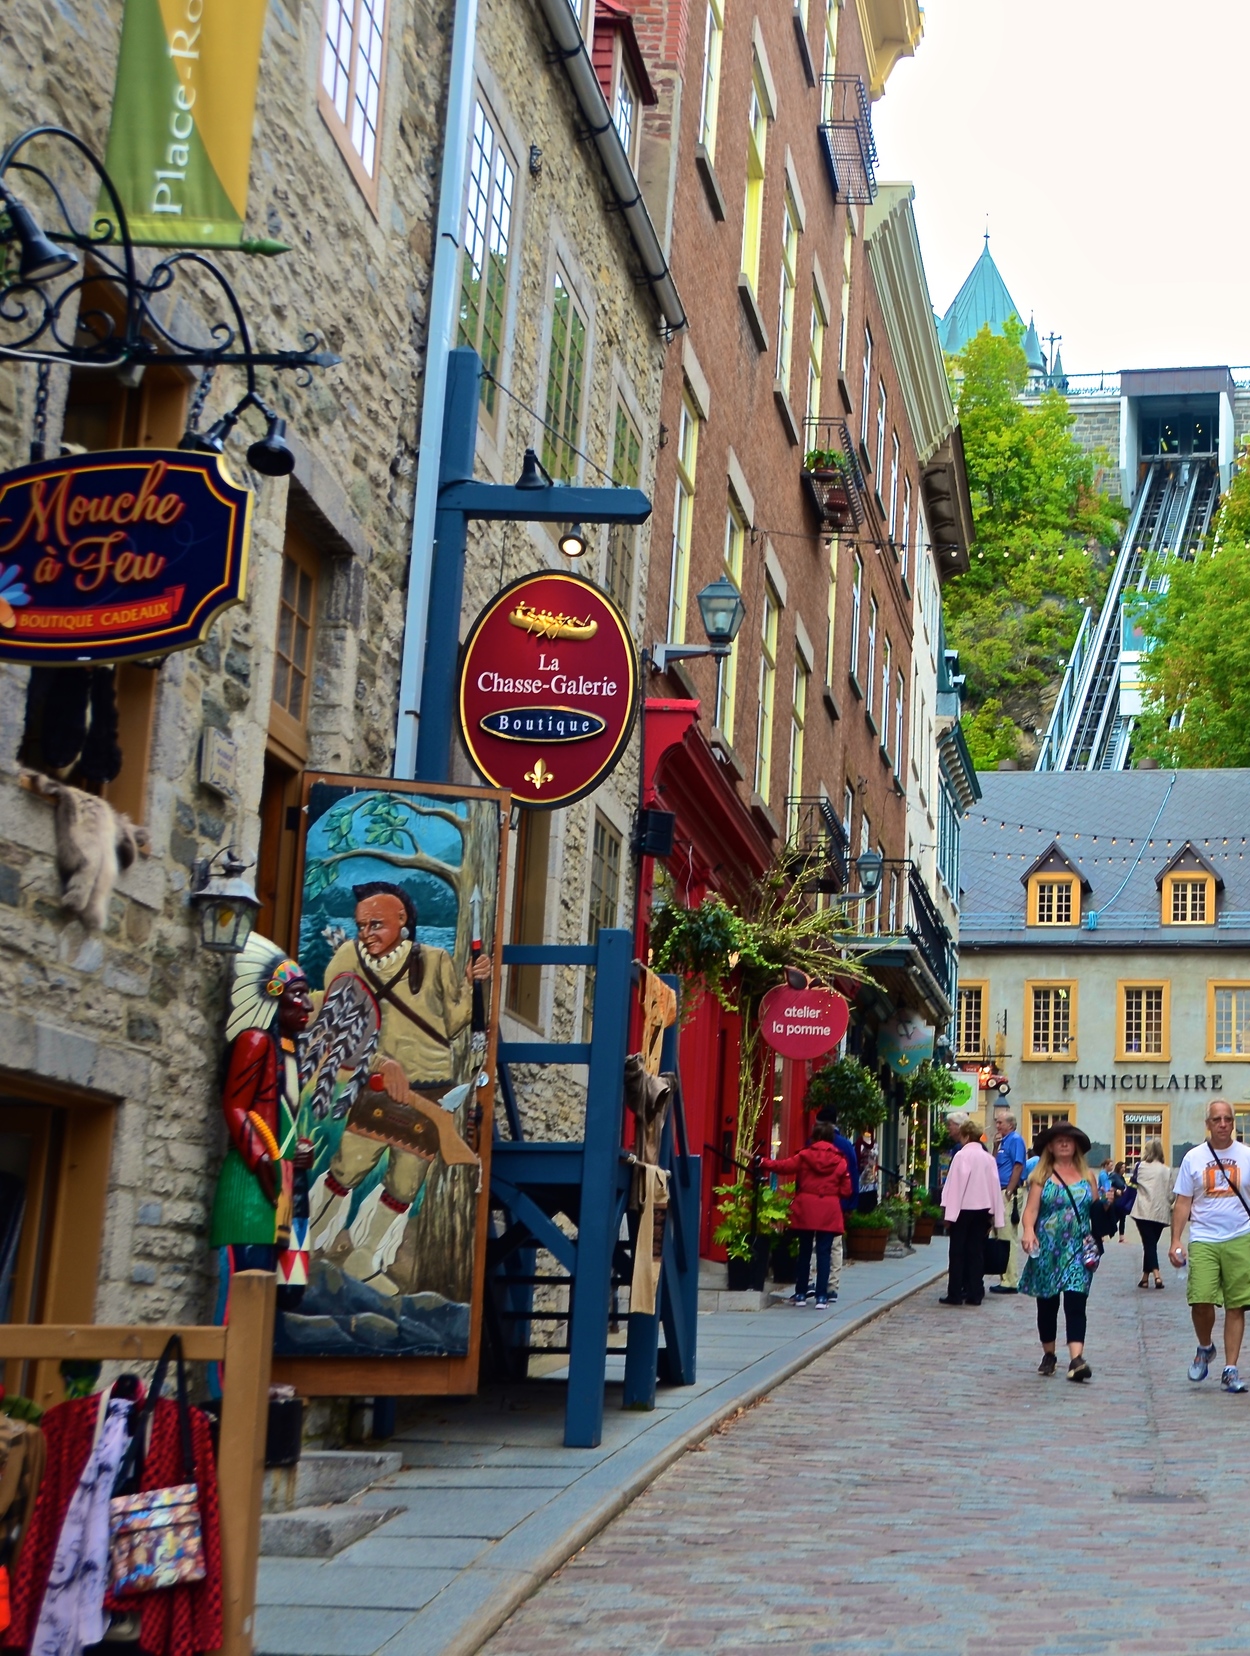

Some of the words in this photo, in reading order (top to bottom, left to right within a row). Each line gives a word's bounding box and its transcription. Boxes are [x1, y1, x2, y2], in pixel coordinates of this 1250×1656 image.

[0, 460, 186, 552] Mouche
[34, 545, 63, 583] à
[68, 531, 166, 591] Feu
[20, 613, 94, 631] BOUTIQUE
[101, 602, 169, 626] CADEAUX
[538, 654, 560, 671] La
[477, 671, 617, 696] Chasse-Galerie
[499, 715, 590, 735] Boutique
[784, 1005, 821, 1018] atelier
[772, 1021, 784, 1033] la
[786, 1024, 831, 1036] pomme
[1062, 1074, 1223, 1090] FUNICULAIRE
[1125, 1114, 1161, 1122] SOUVENIRS
